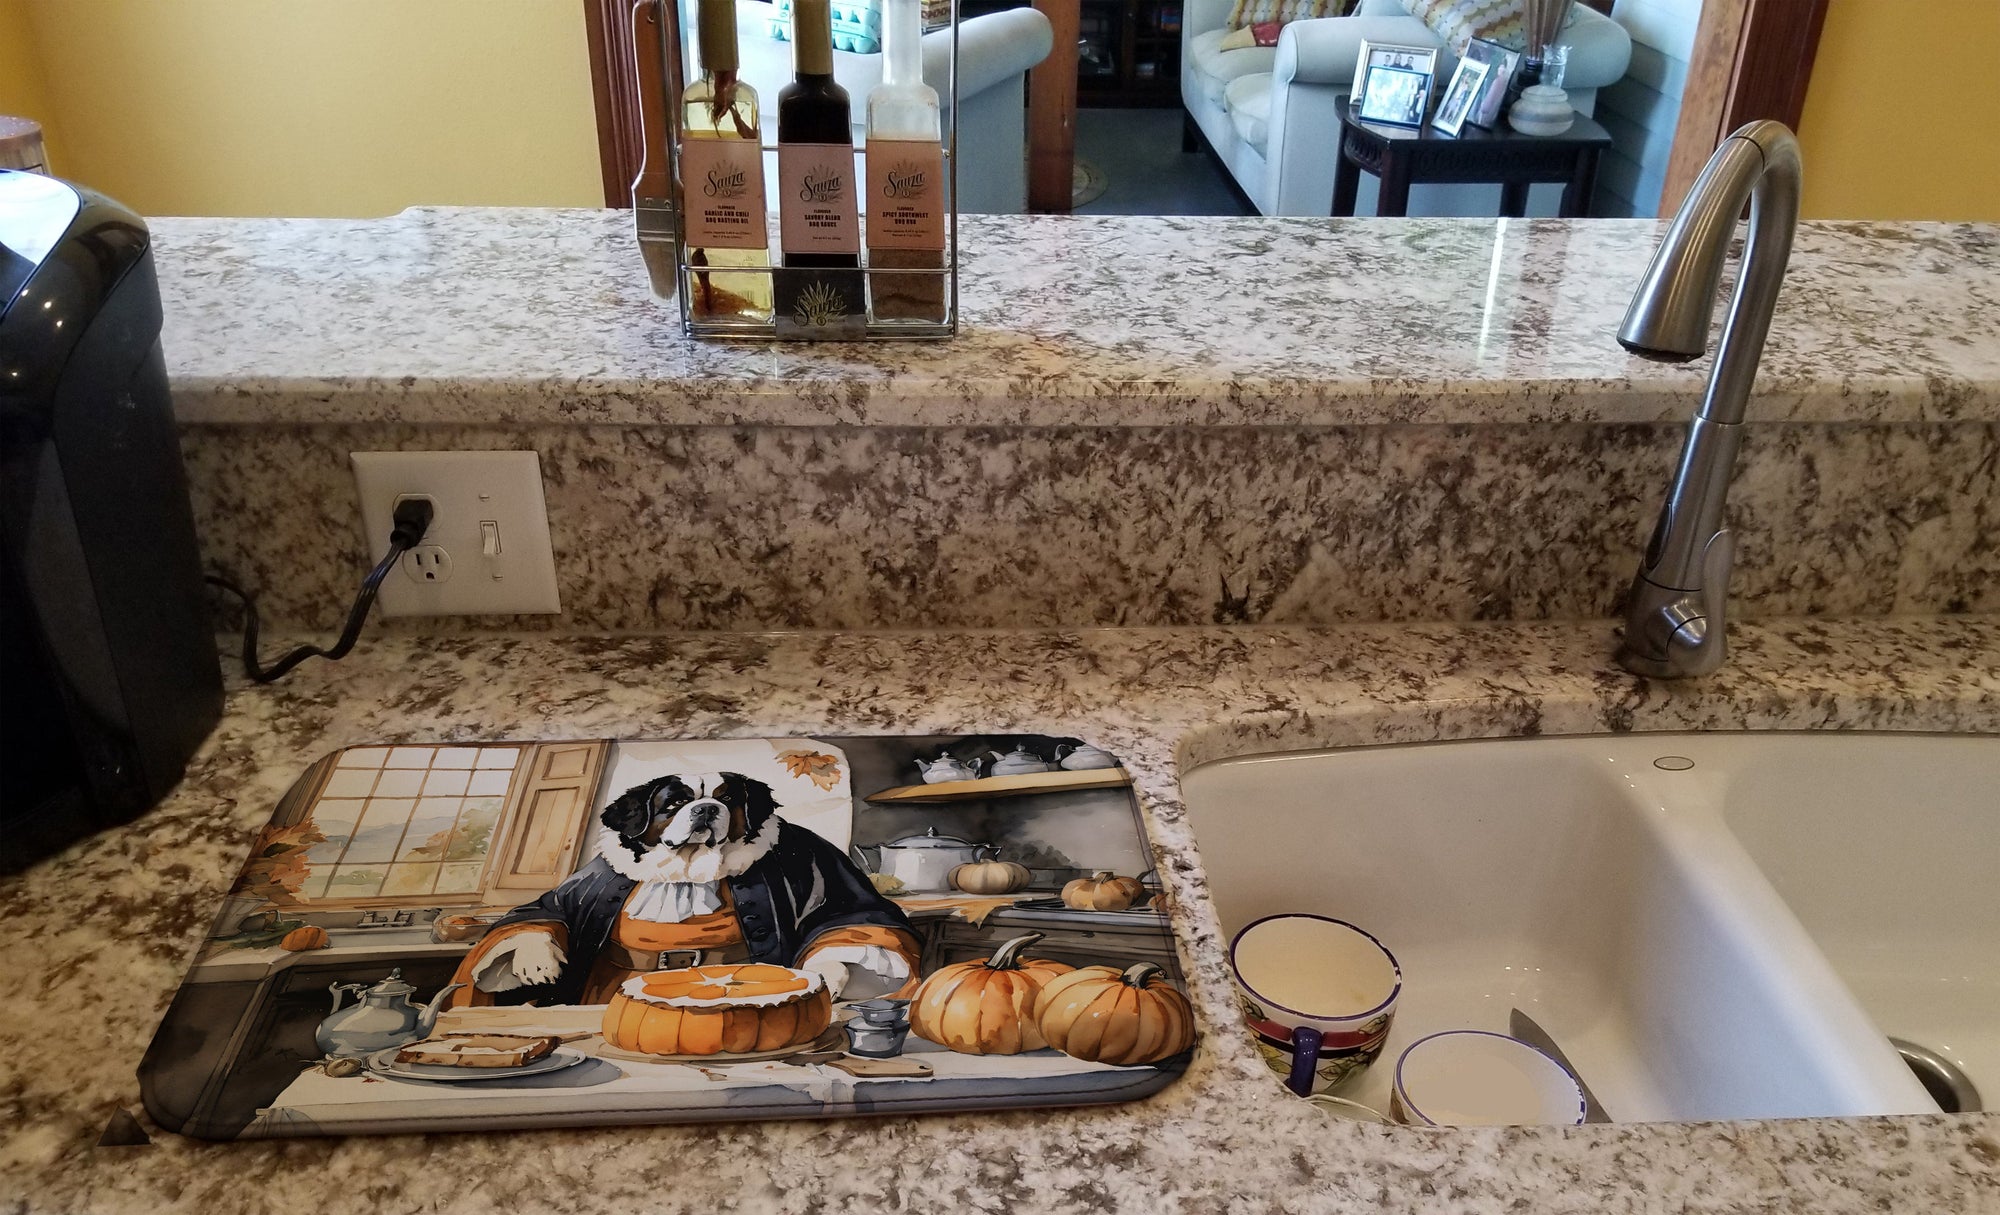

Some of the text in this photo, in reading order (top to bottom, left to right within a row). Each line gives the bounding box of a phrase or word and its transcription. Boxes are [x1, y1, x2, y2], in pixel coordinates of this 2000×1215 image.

[704, 170, 746, 197] Sauza
[800, 175, 842, 202] Sauza
[883, 171, 925, 198] Sauza
[717, 217, 740, 225] BASTING
[793, 294, 845, 327] Sauza
